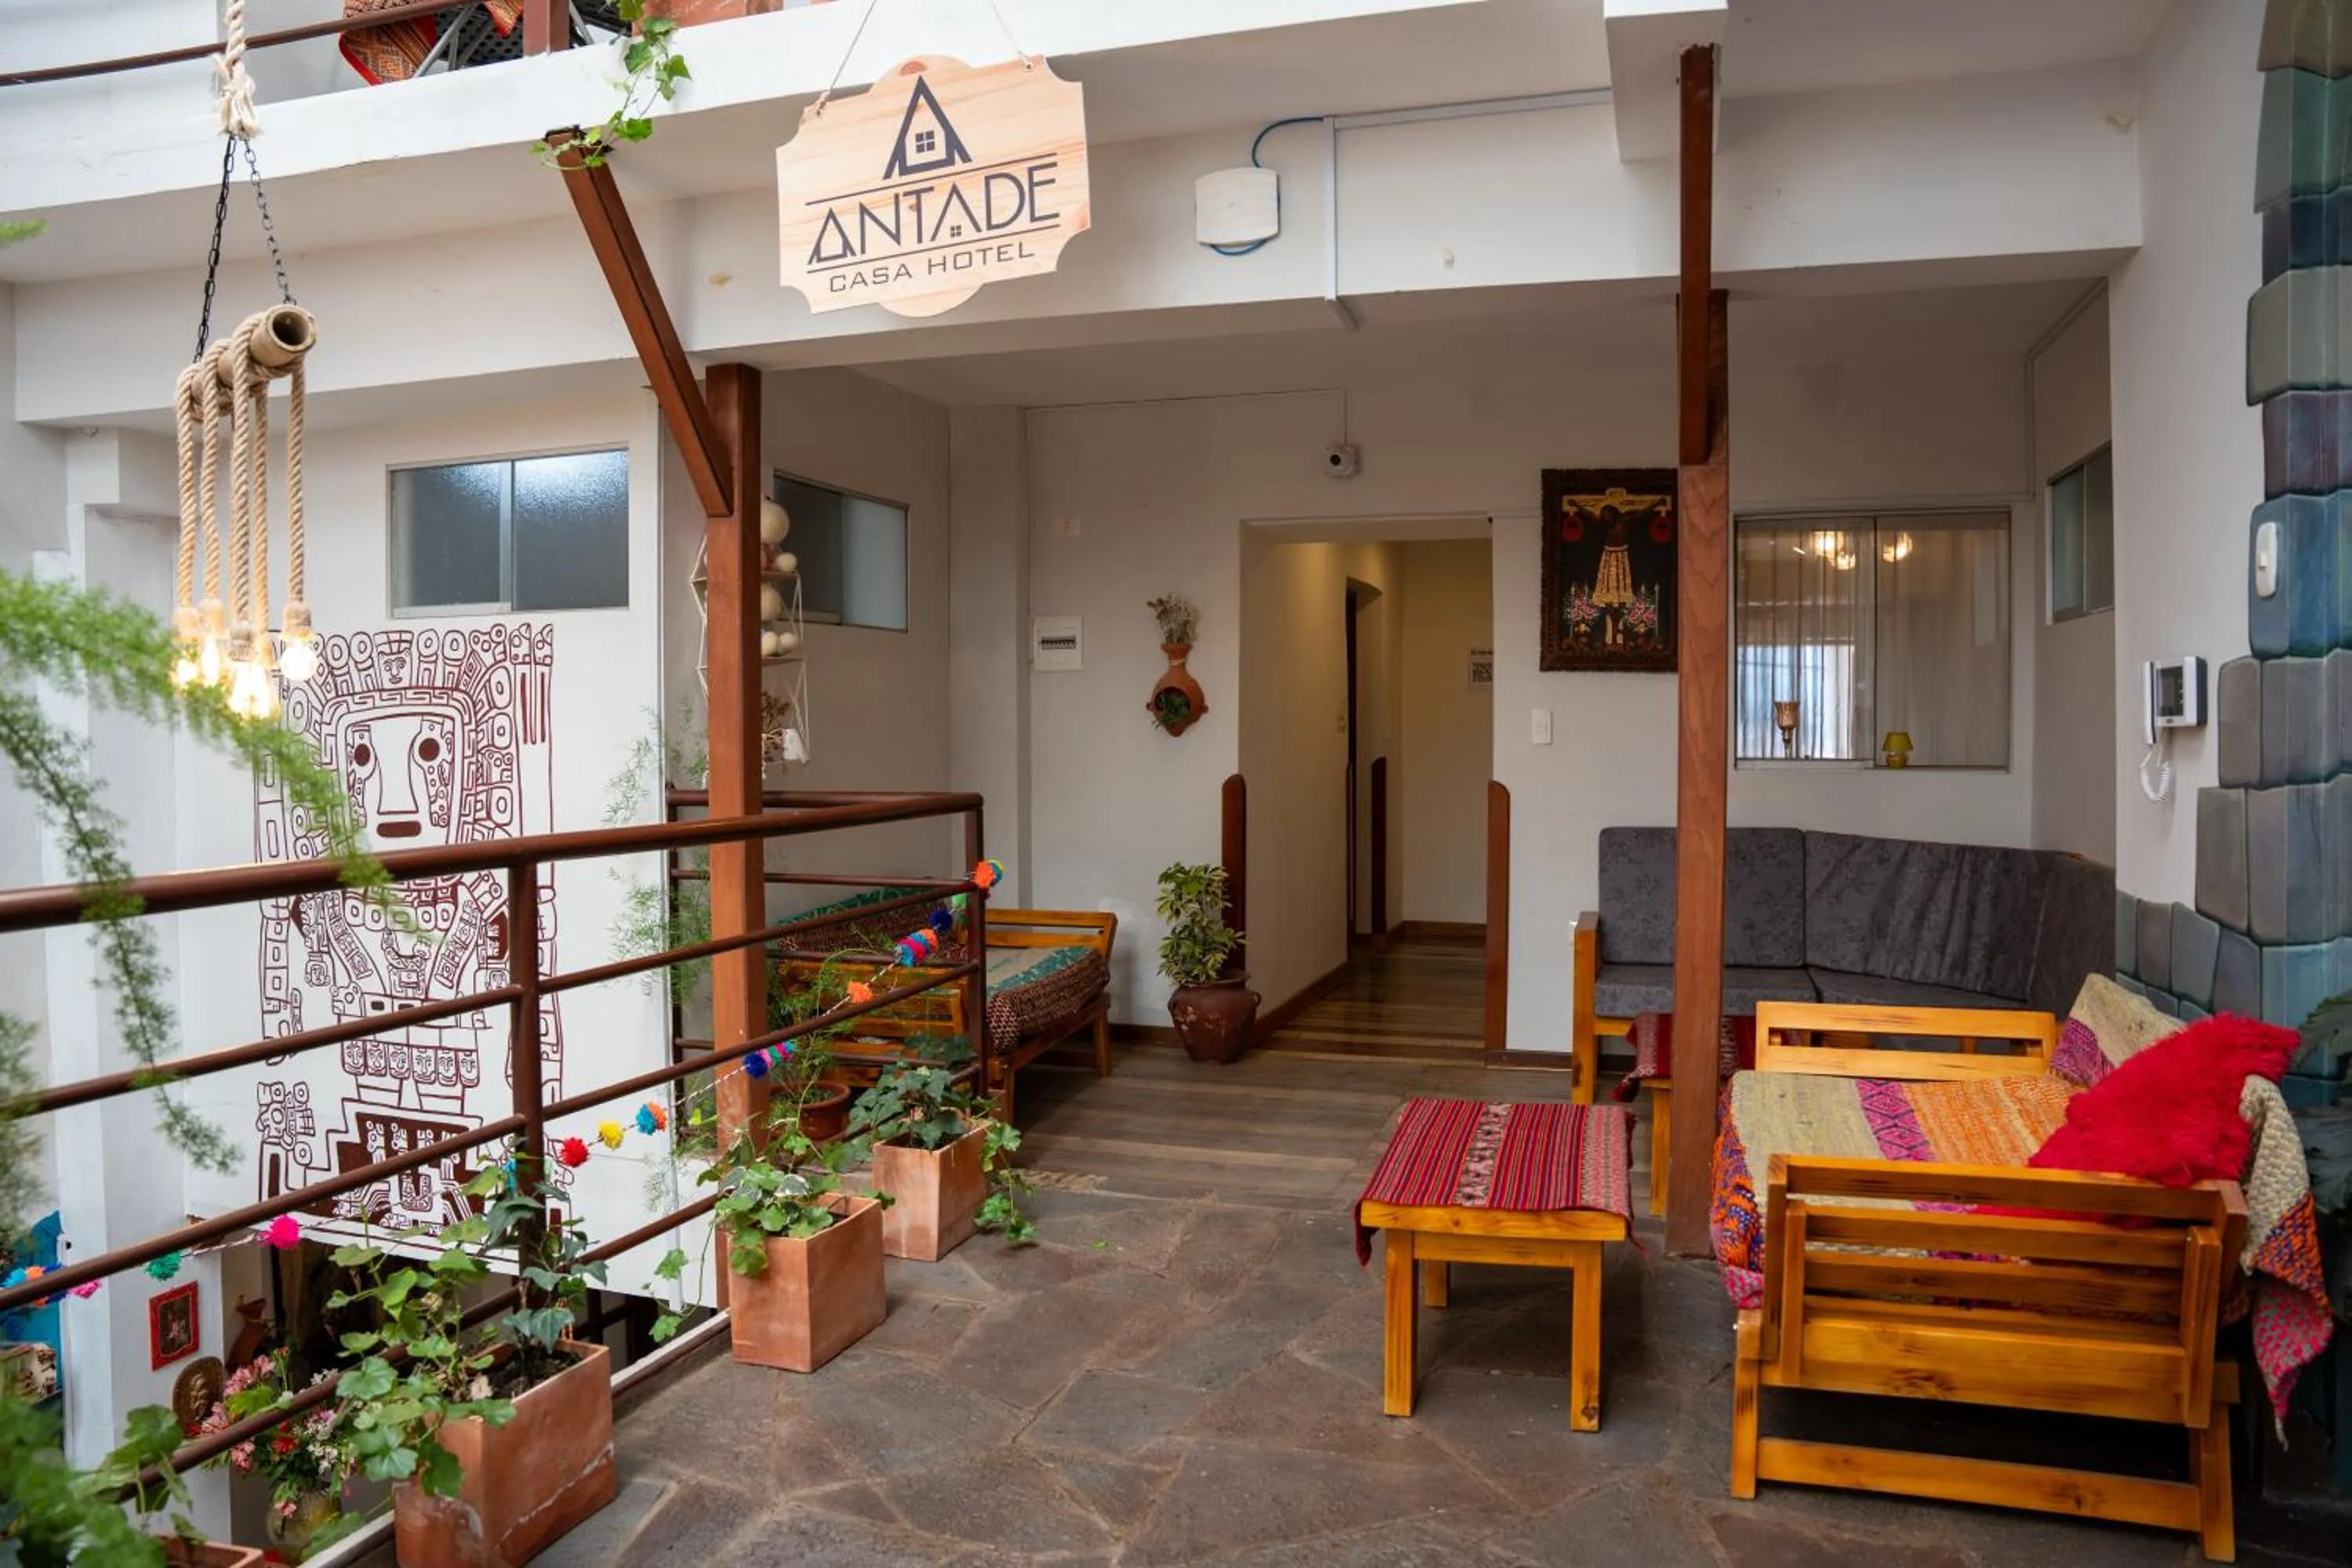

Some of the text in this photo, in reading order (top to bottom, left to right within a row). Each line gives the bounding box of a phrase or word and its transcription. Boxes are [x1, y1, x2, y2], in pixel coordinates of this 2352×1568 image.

[808, 162, 1060, 265] ANTADE
[829, 241, 1035, 292] CASA HOTEL
